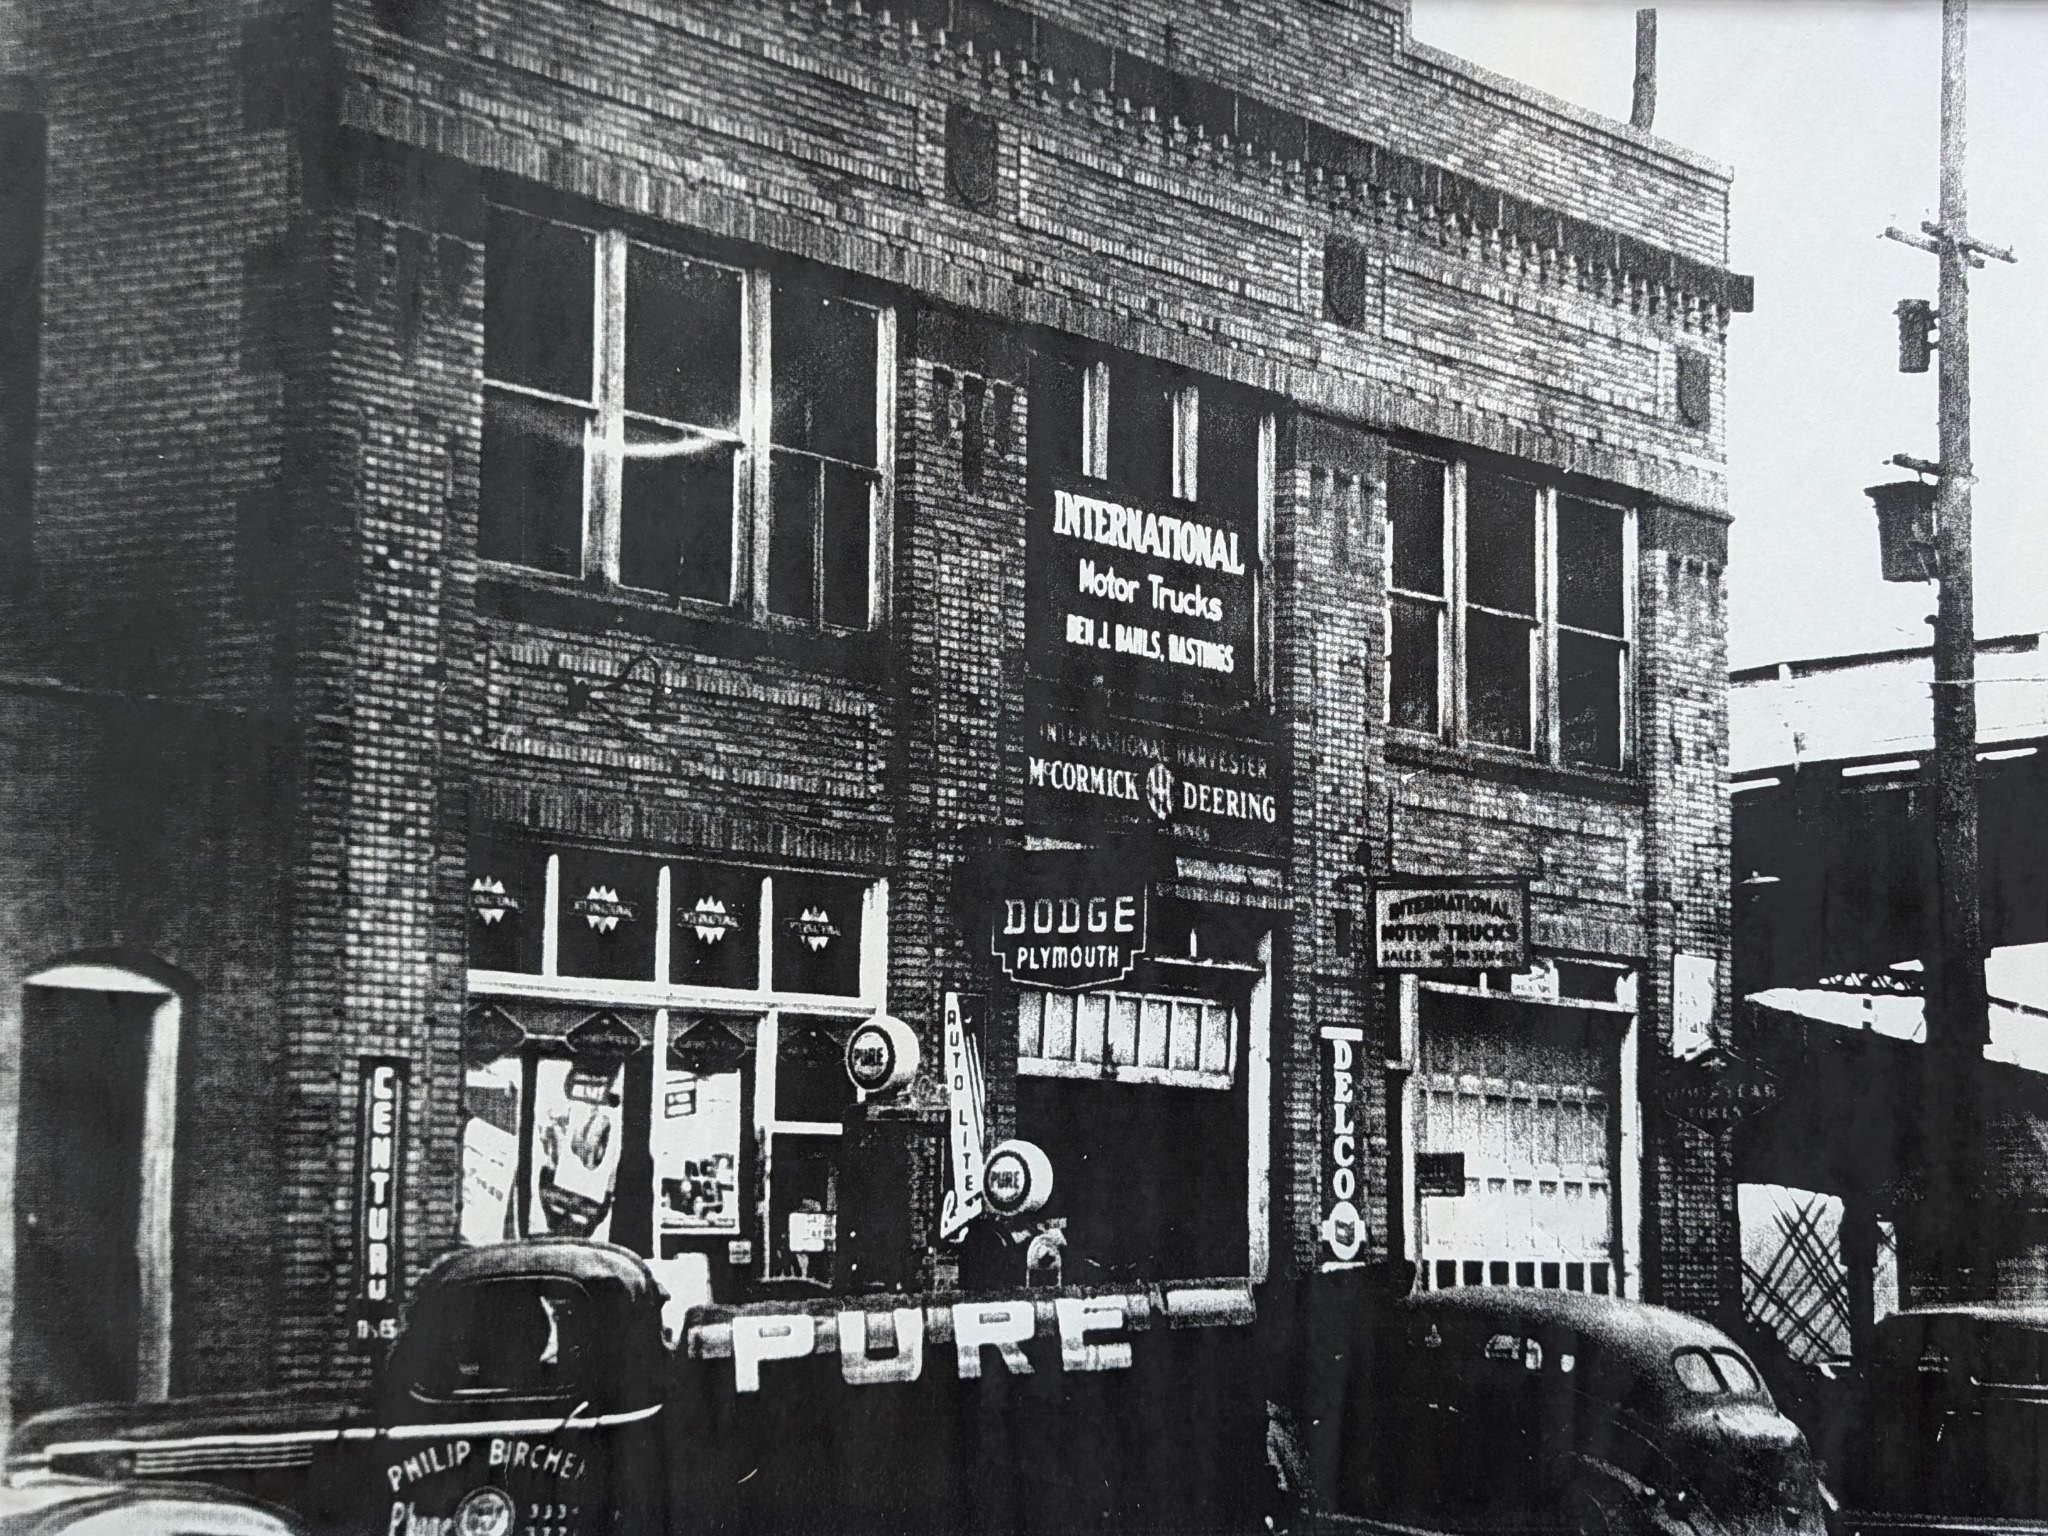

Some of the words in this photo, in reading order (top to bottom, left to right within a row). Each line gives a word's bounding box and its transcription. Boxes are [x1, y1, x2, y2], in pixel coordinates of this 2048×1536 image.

[1053, 490, 1245, 576] INTERNATIONAL
[1079, 558, 1140, 603] Motor
[1147, 573, 1223, 622] Trucks
[1182, 781, 1276, 823] DEERING
[1003, 896, 1136, 935] DODGE
[1445, 923, 1518, 943] TRUCKS
[1017, 944, 1118, 970] PLYMOUTH
[1333, 1039, 1355, 1200] DELCO
[990, 1170, 1020, 1189] PURE
[733, 1297, 1132, 1393] PURE
[387, 1440, 471, 1492] PHILIP
